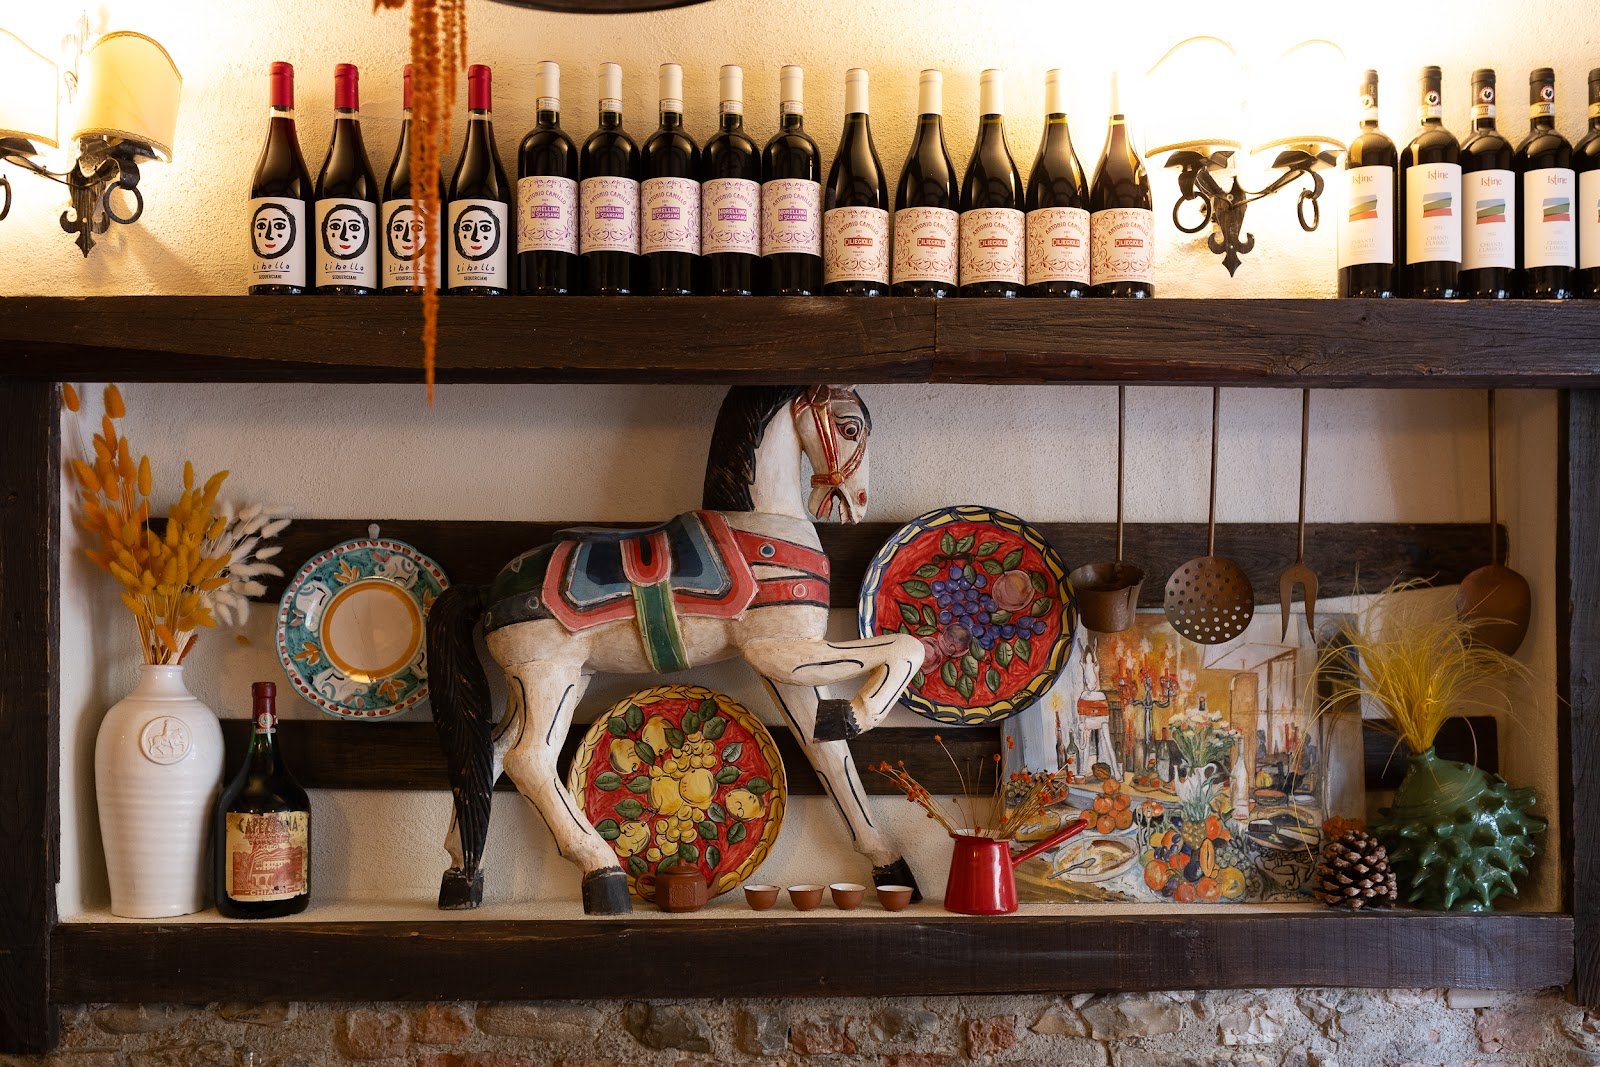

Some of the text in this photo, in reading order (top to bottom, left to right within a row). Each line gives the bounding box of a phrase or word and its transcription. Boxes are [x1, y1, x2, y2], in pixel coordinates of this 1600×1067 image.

[525, 190, 567, 205] ANTONIO CAMILLO
[589, 190, 631, 206] ANTONIO CAMILLO
[646, 192, 687, 206] ANTONIO CAMILLO
[712, 192, 753, 208] ANTONIO CAMILLO
[772, 192, 813, 208] ANTONIO CAMILLO
[838, 220, 880, 235] ANTONIO CAMILLO
[911, 221, 952, 237] ANTONIO CAMILLO
[972, 222, 1015, 236] ANTONIO CAMILLO
[1045, 222, 1085, 236] ANTONIO CAMILLO
[1108, 222, 1149, 237] ANTONIO CAMILLO
